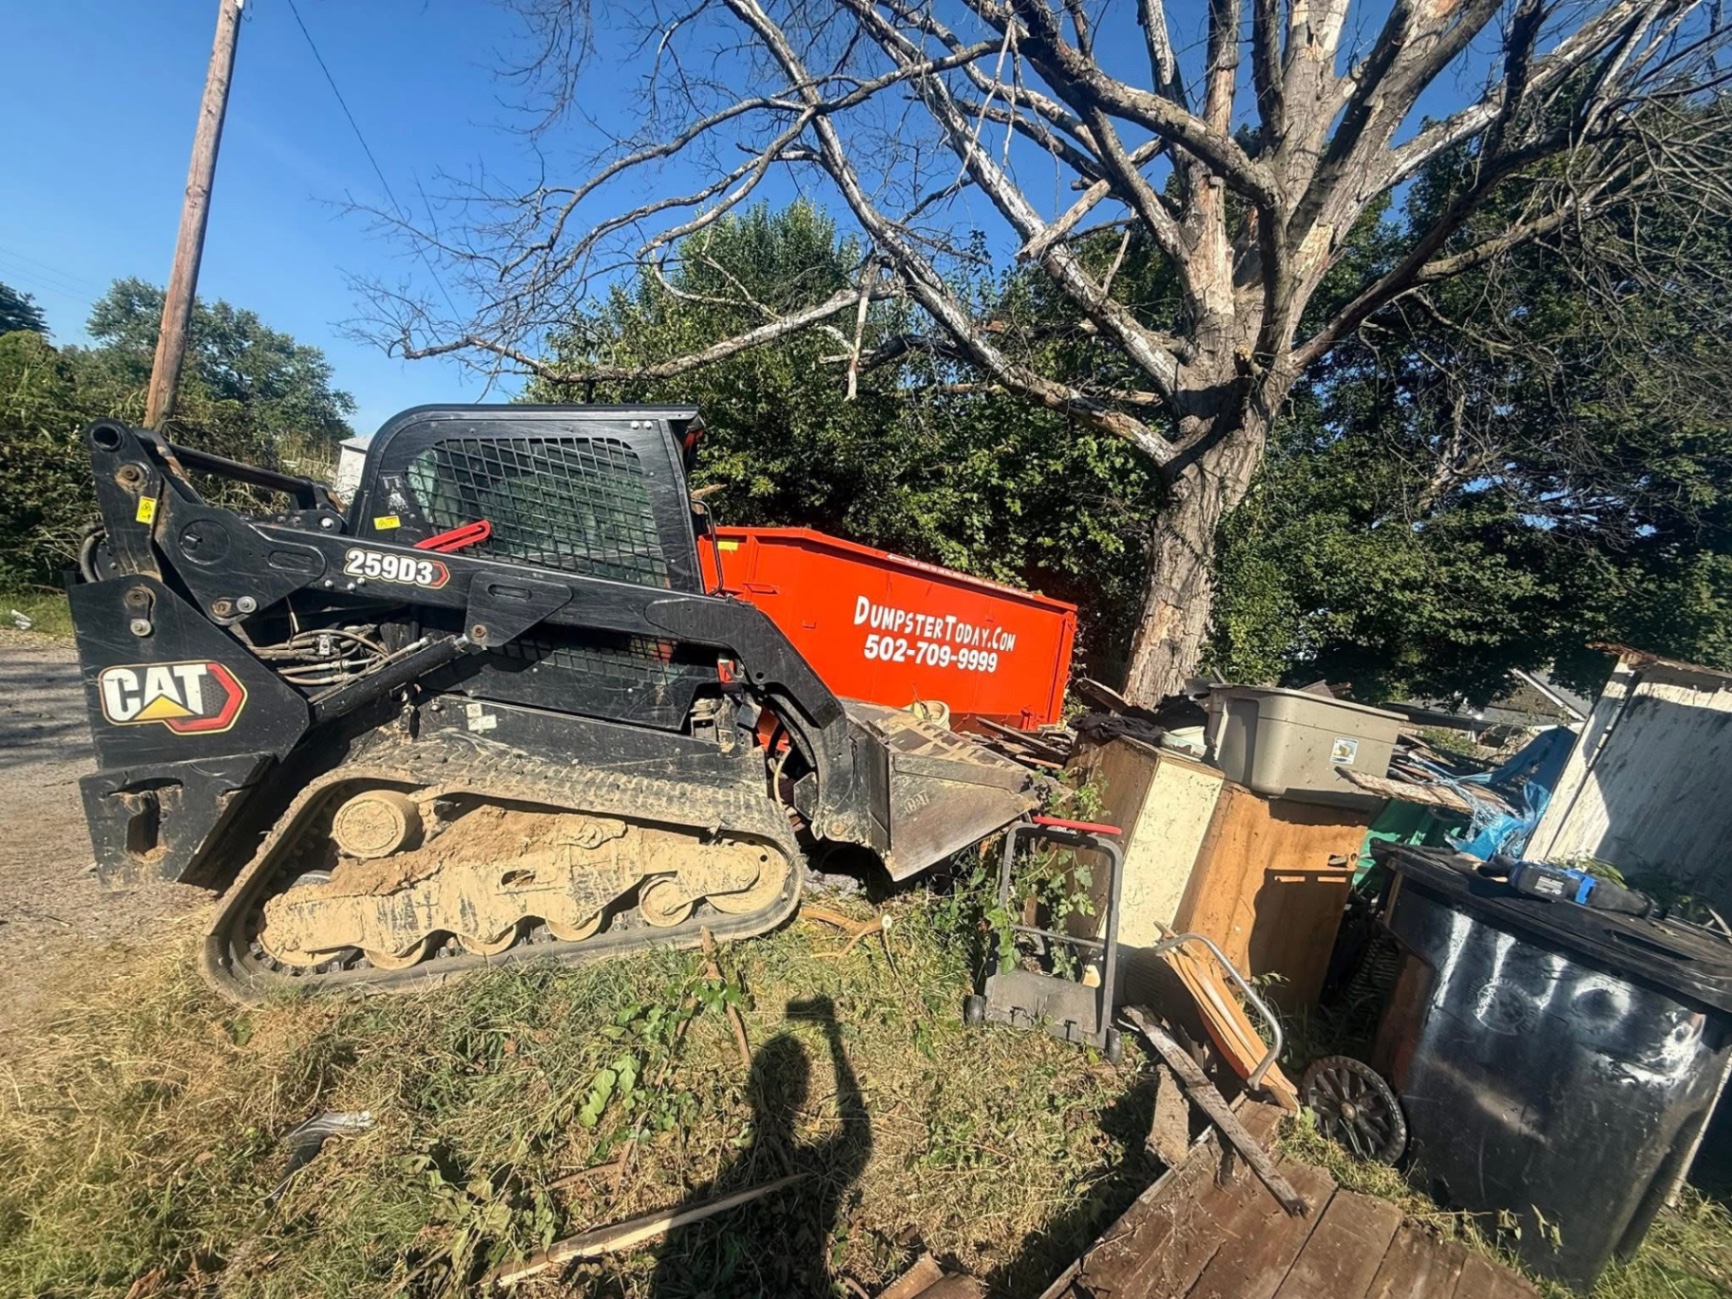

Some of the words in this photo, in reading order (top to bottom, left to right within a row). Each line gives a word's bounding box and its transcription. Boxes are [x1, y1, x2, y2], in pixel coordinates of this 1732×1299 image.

[346, 550, 433, 585] 259D3
[864, 633, 999, 673] 502-709-9999
[102, 663, 207, 722] CAT
